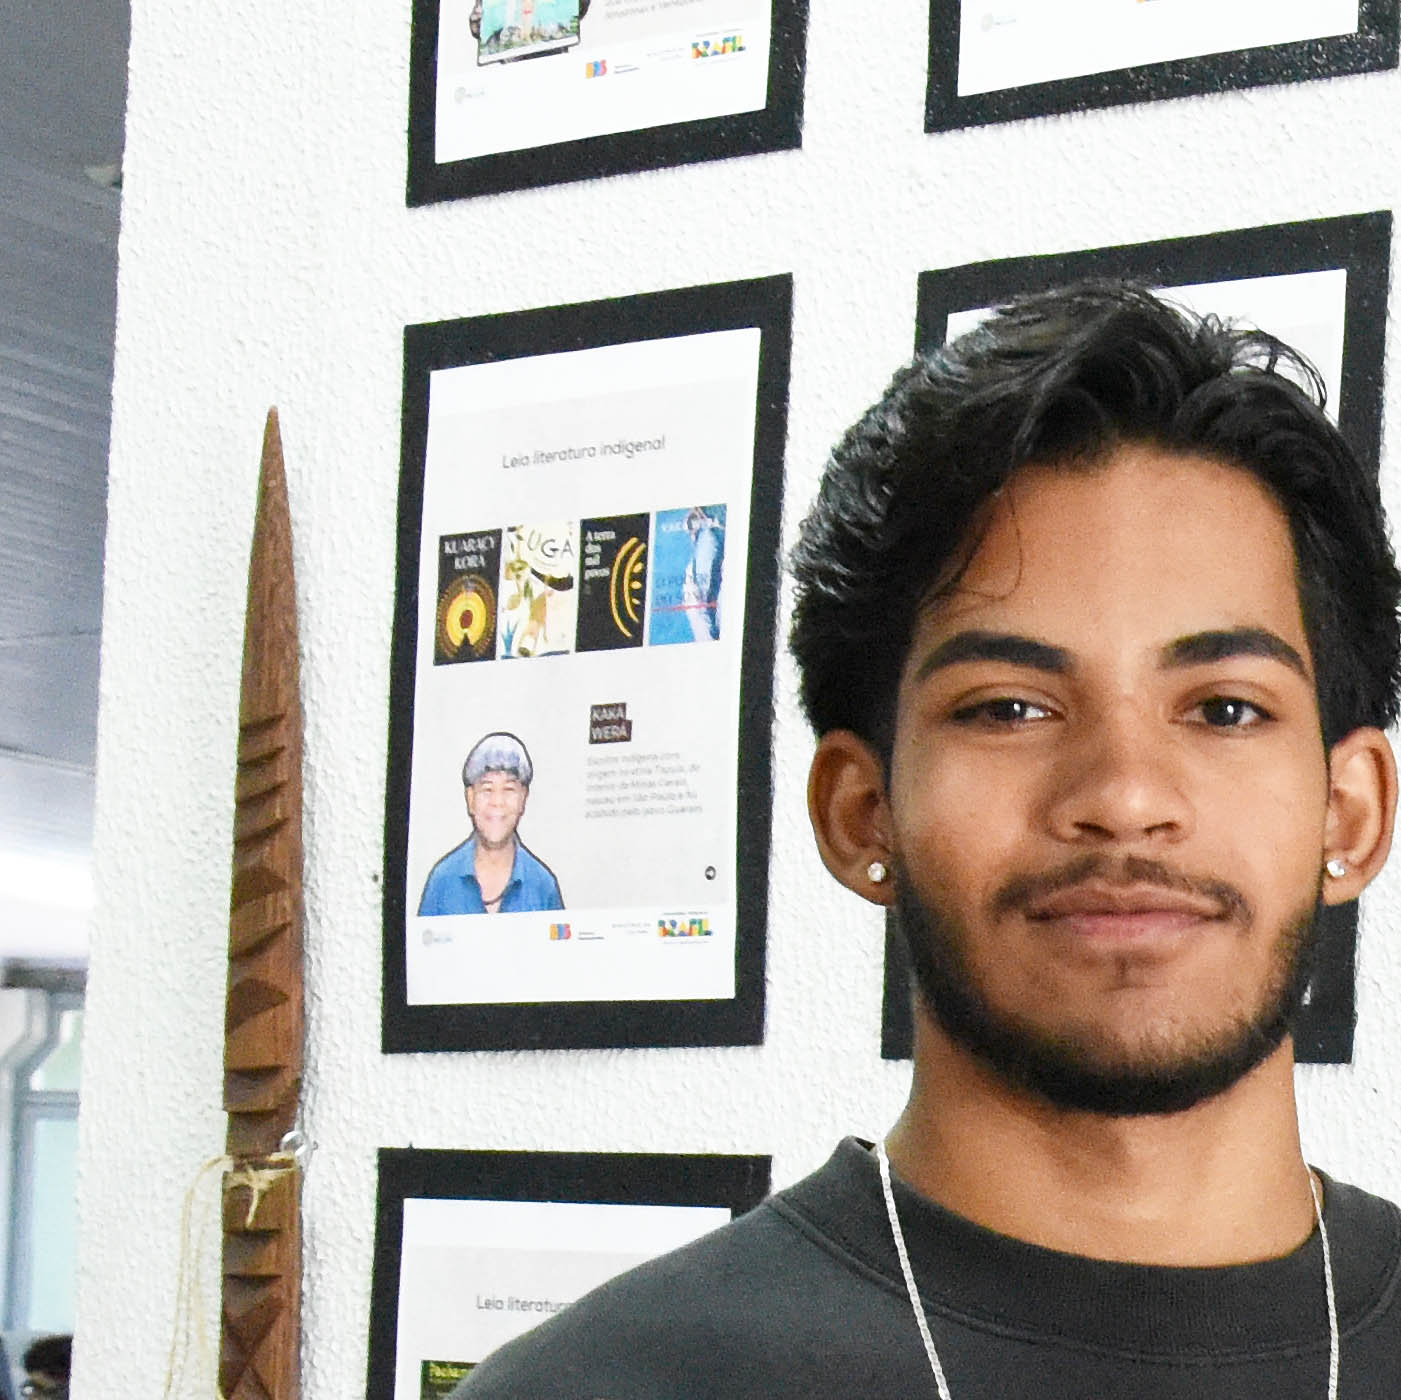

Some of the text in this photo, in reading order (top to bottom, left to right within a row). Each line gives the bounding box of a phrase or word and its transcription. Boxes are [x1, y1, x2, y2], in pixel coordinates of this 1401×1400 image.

[502, 453, 531, 469] Leia
[533, 441, 597, 466] literatura
[476, 1293, 568, 1313] Leia literatur
